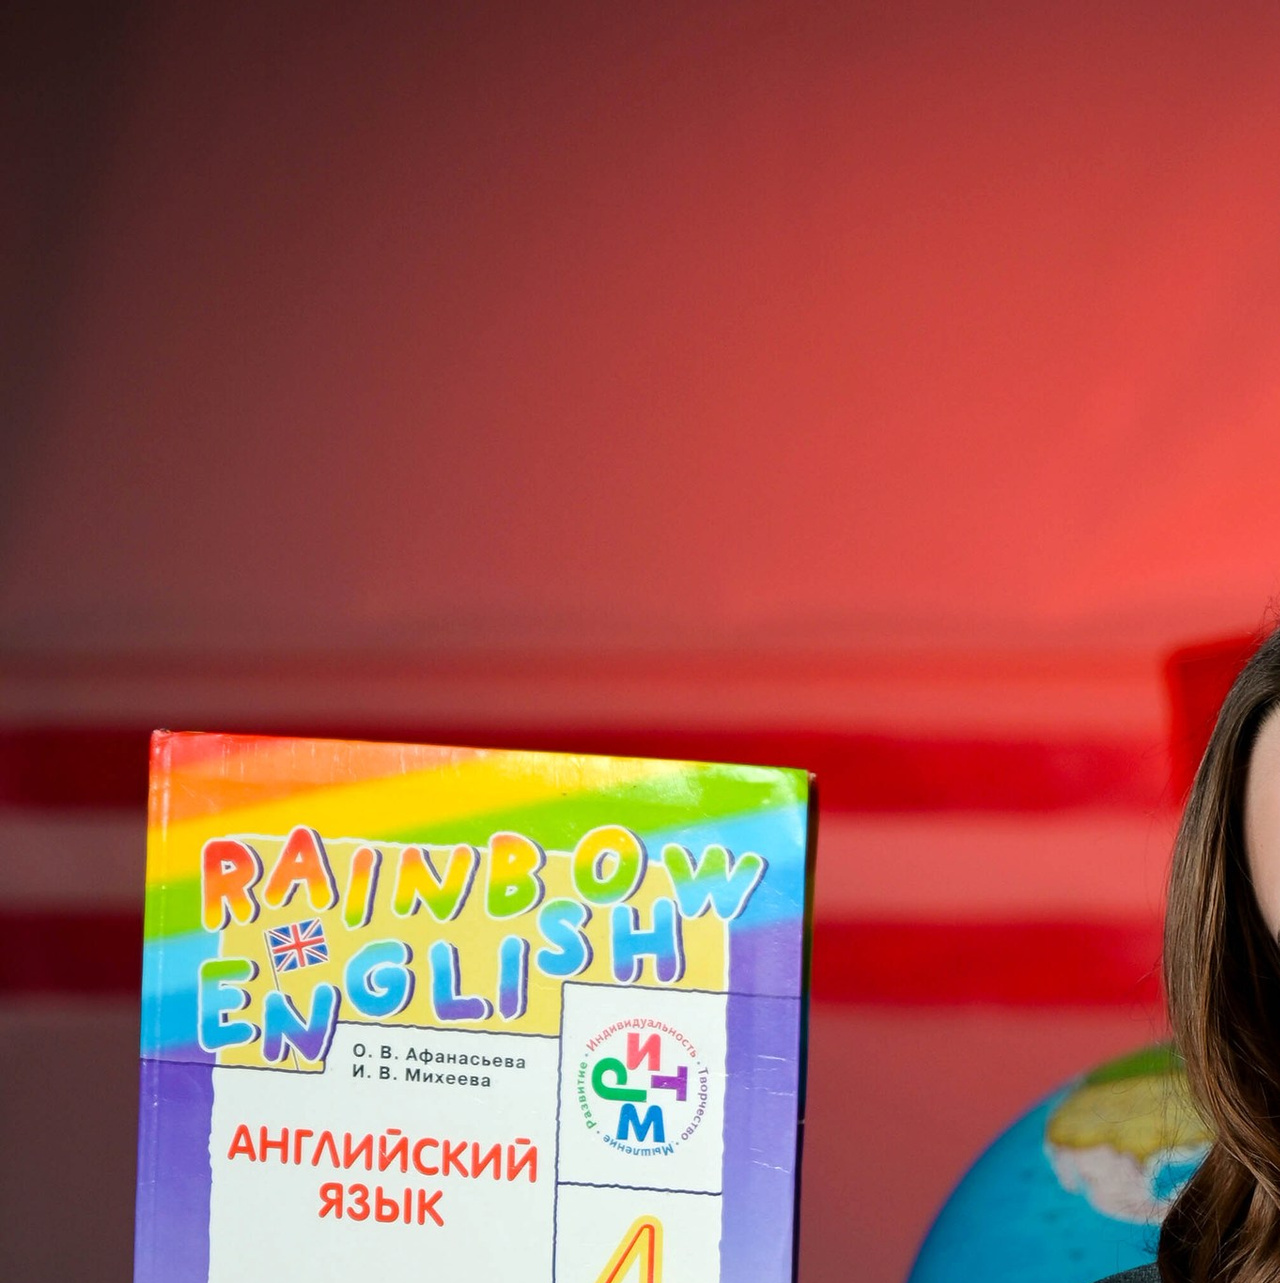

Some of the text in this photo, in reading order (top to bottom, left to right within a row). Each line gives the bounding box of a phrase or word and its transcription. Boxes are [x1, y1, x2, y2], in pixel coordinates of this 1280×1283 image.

[202, 826, 769, 930] RAINBOW
[199, 899, 684, 1063] ENGLISH
[353, 1043, 526, 1069] О. В. Афанасьева
[587, 1018, 697, 1058] Индивидуальность
[353, 1064, 491, 1087] И. В. Михеева
[578, 1062, 596, 1129] Развитие
[682, 1067, 709, 1140] Творчество
[227, 1124, 538, 1183] АНГЛИЙСКИЙ
[604, 1135, 674, 1156] Мышление
[318, 1182, 445, 1227] ЯЗЫК
